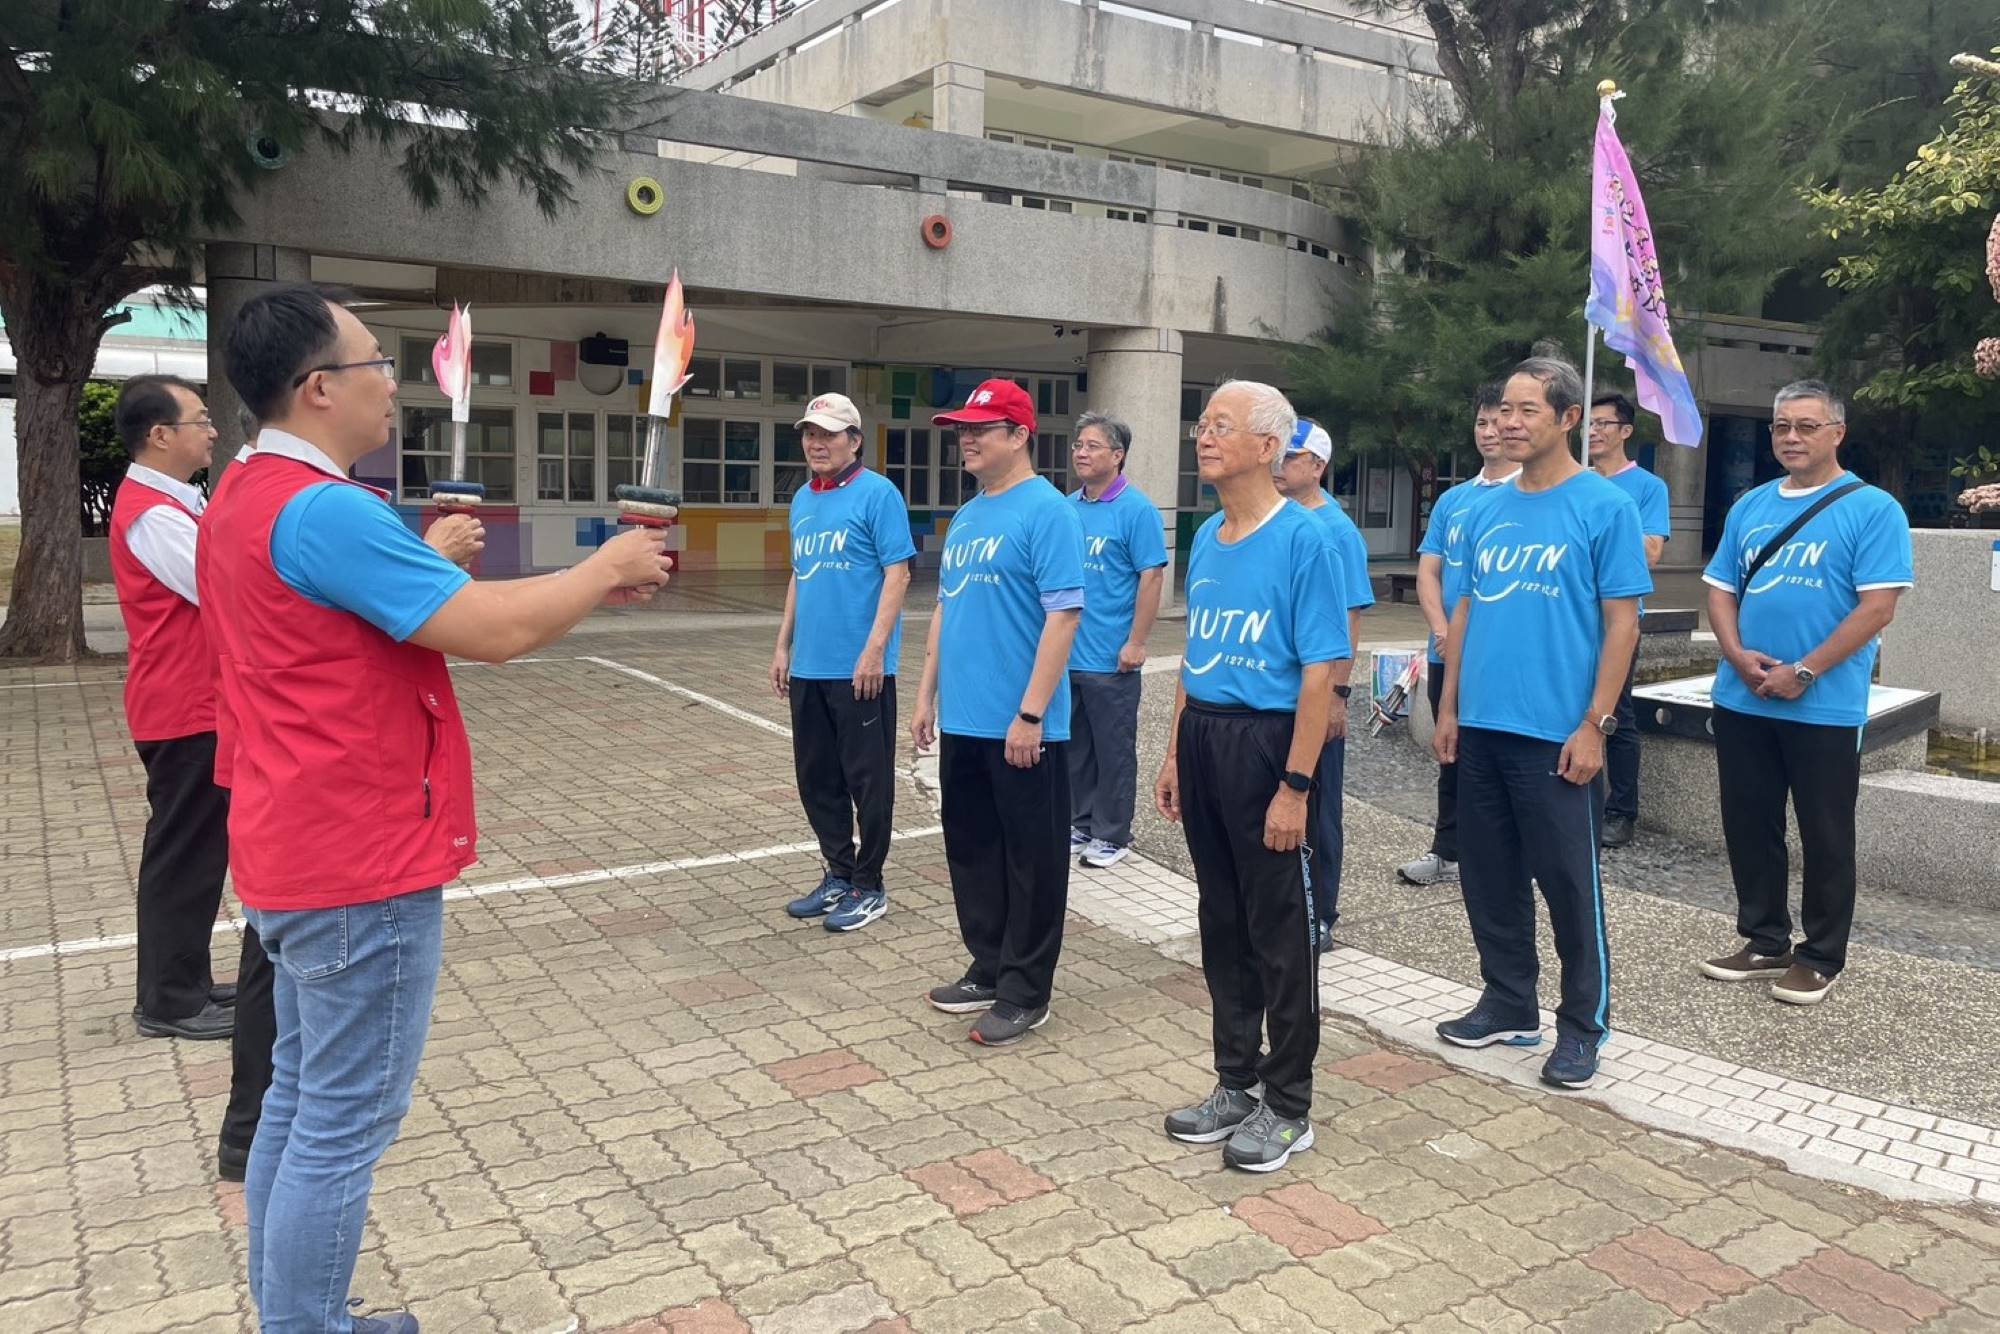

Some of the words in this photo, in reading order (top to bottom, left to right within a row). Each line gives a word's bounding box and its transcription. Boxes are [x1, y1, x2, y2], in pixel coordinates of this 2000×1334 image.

[794, 527, 849, 561] NUTN
[943, 534, 1004, 571] NUTN
[1479, 543, 1568, 573] NUTN
[1189, 604, 1271, 644] NUTN
